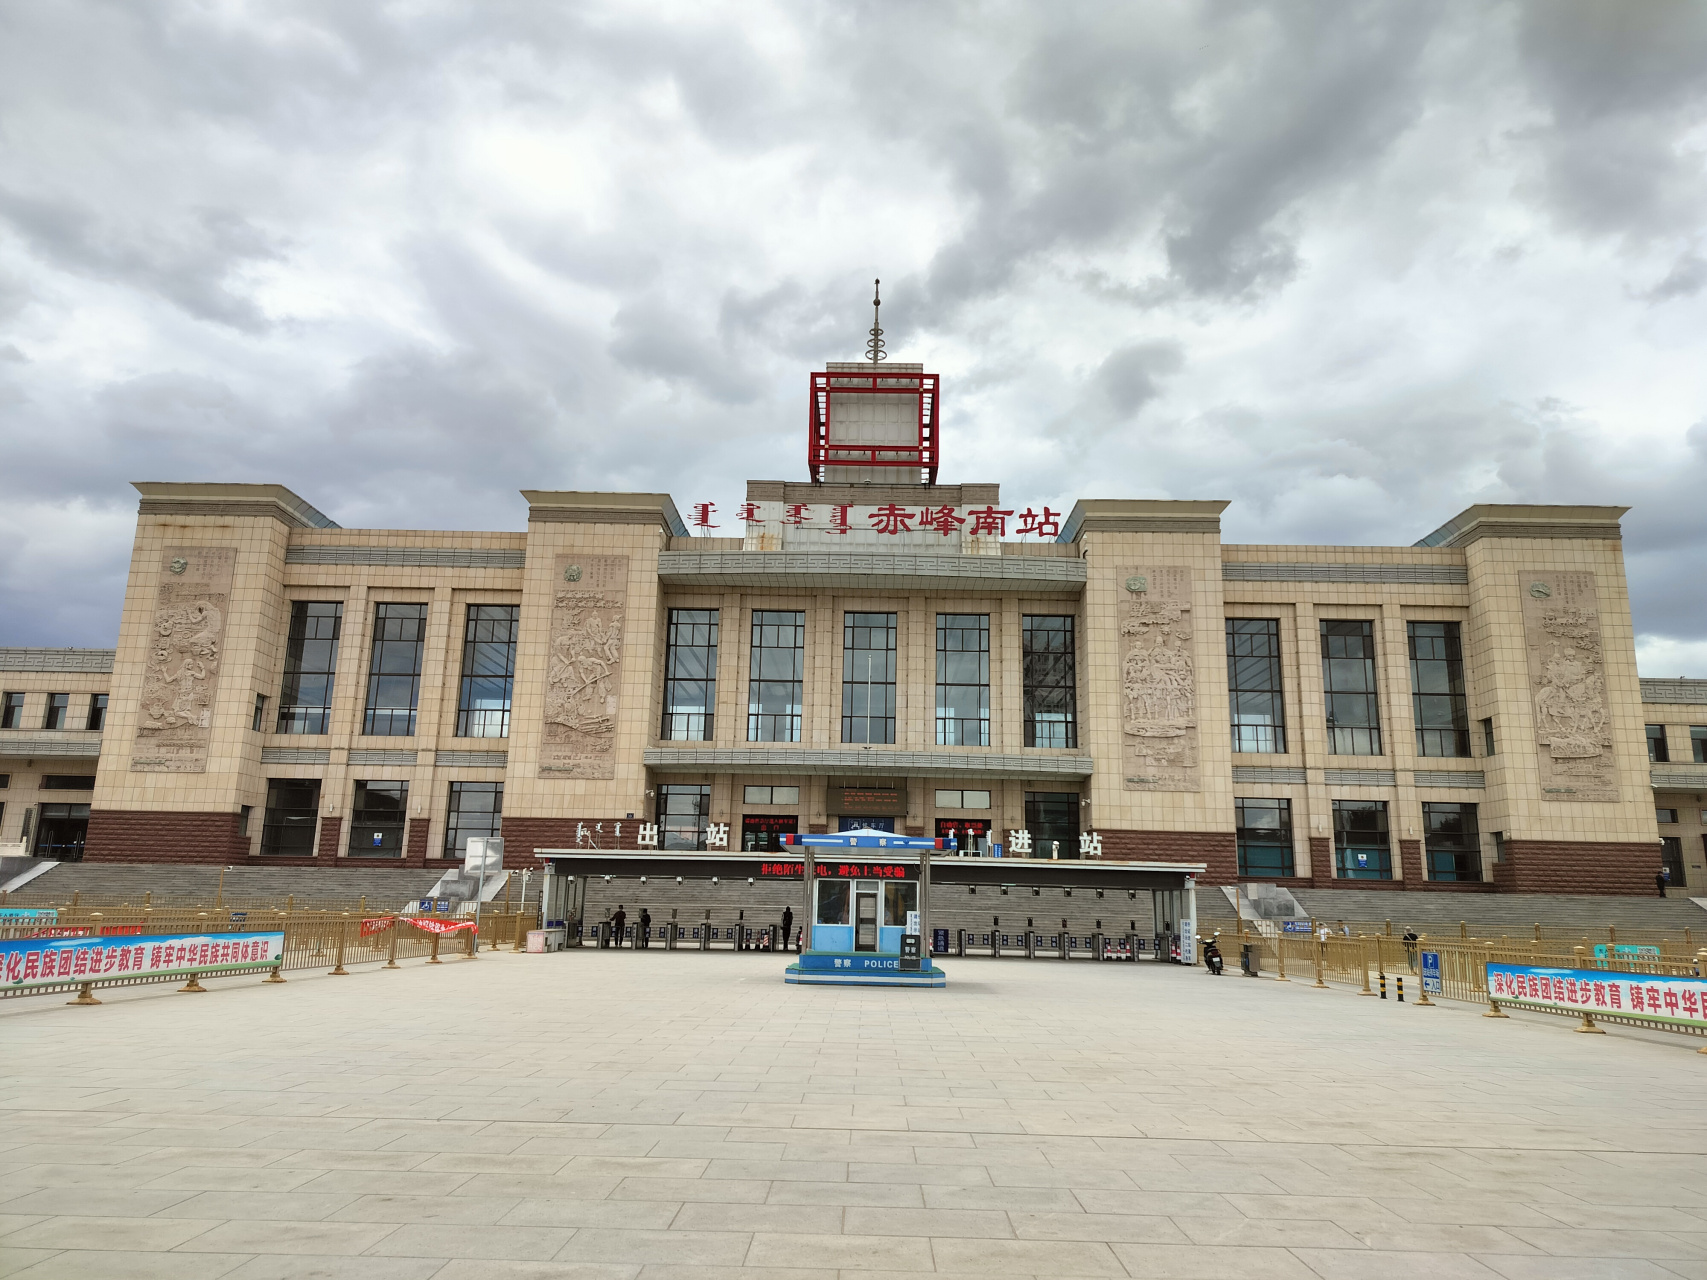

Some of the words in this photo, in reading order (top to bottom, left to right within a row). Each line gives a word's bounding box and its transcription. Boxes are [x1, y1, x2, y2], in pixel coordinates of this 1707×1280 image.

[868, 503, 1062, 537] 赤峰南站
[761, 863, 906, 878] 拒绝陌生电，避免上当受骗
[150, 940, 269, 971] 铸牢中华民族共同体意识
[834, 958, 852, 968] 警察
[864, 960, 899, 969] POLICE
[1493, 971, 1622, 1009] 深化民族团结进步教育
